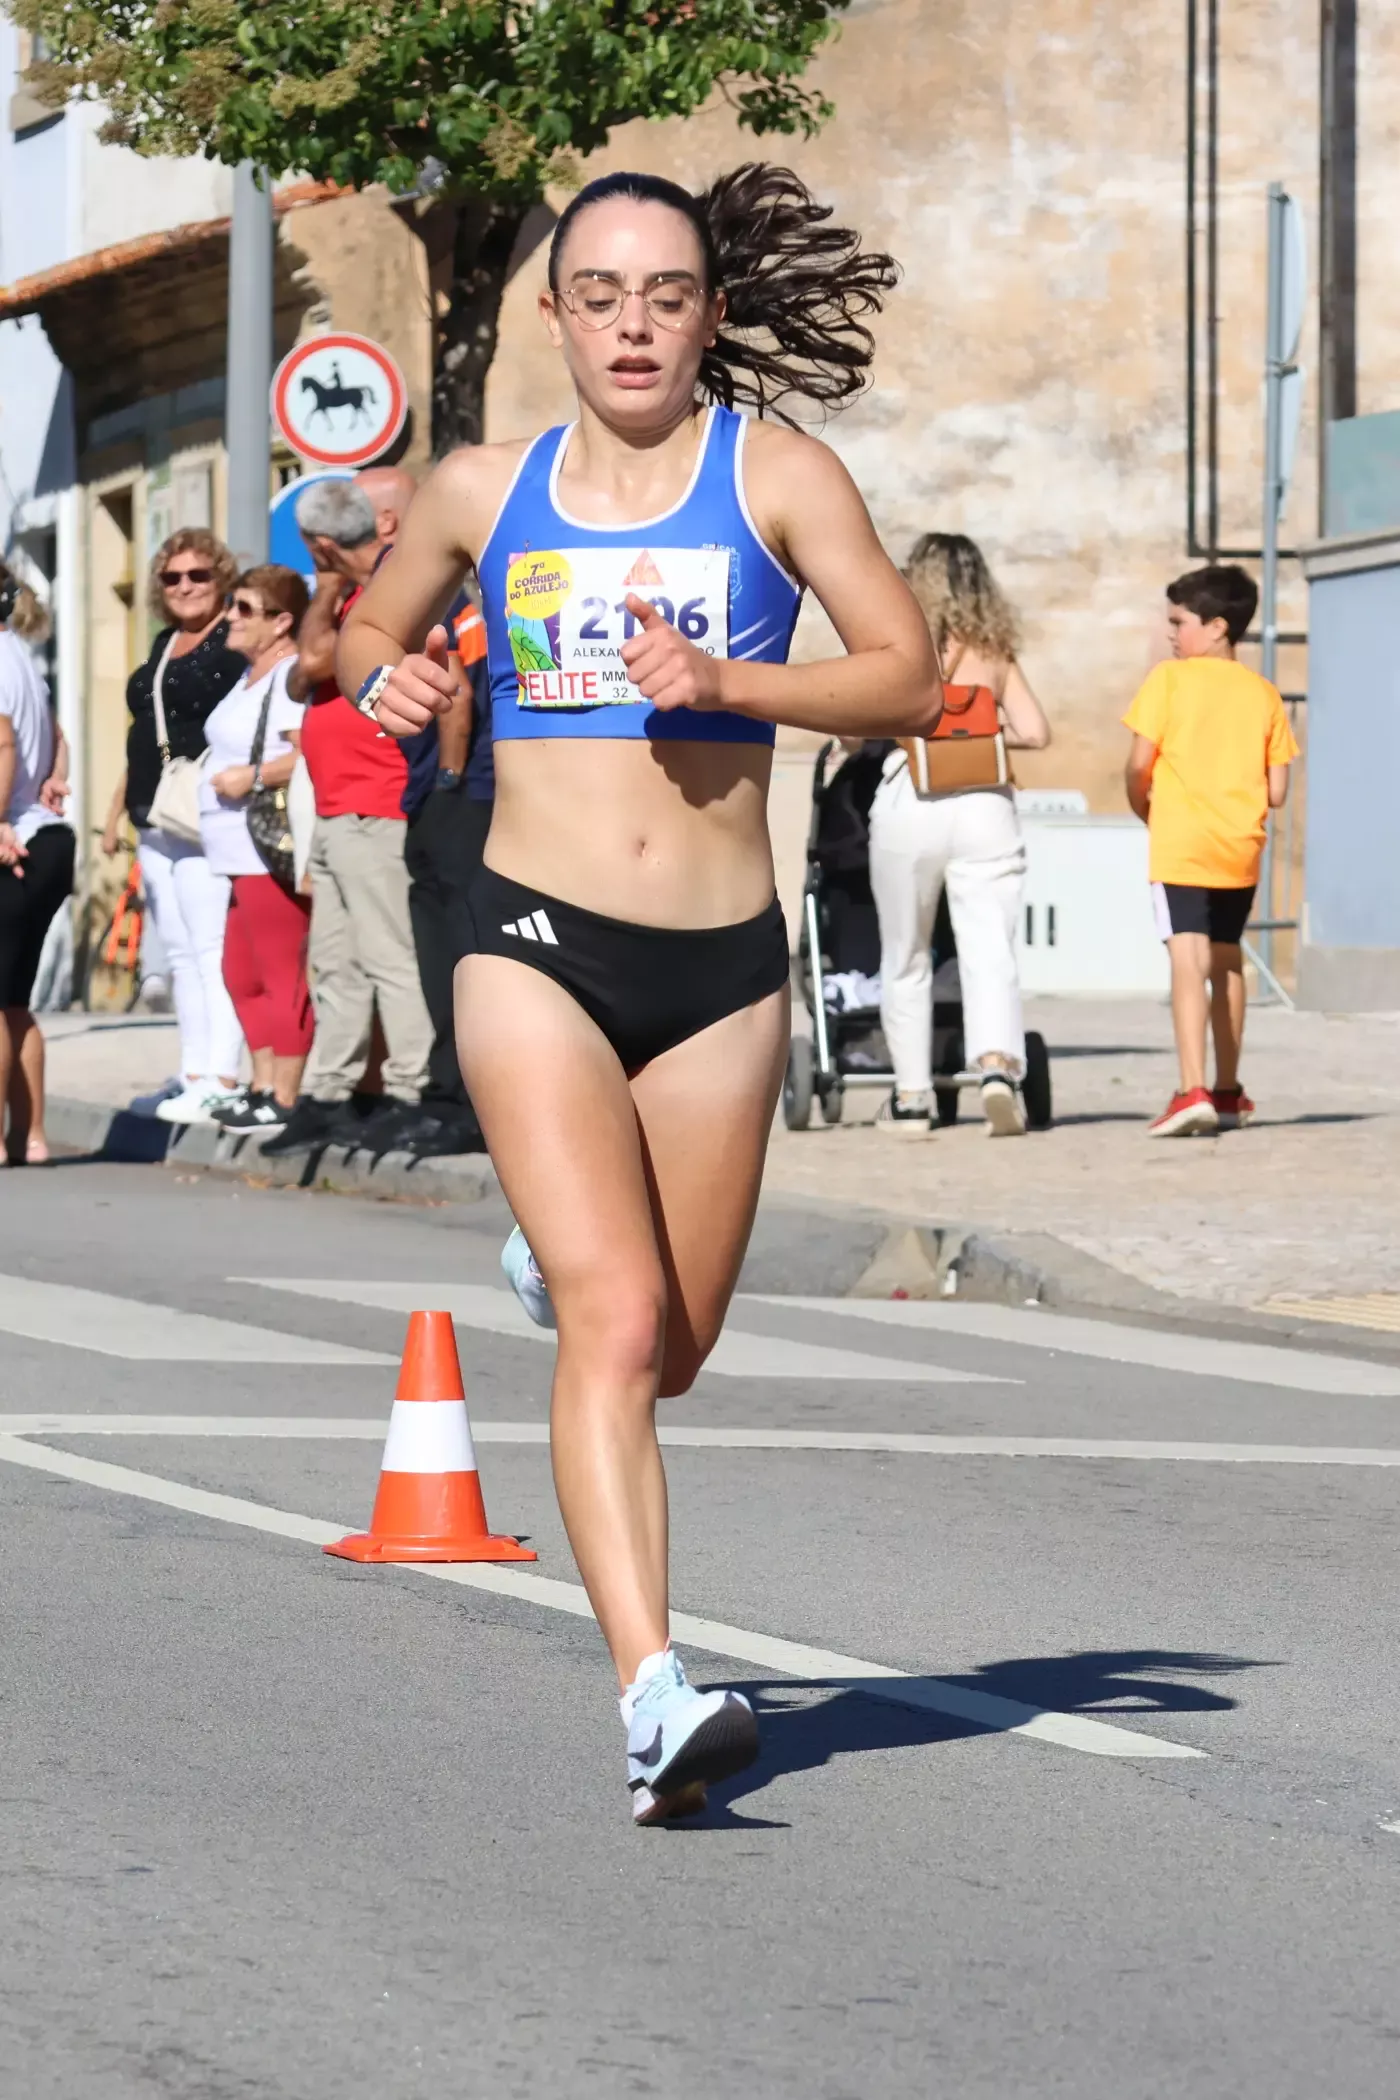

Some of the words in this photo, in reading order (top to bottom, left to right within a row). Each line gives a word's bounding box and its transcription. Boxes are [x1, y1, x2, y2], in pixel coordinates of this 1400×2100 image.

[514, 571, 561, 589] CORRIDA
[510, 591, 521, 600] DO
[524, 580, 569, 597] AZULEJO
[527, 671, 598, 701] ELITE
[612, 687, 629, 698] 32
